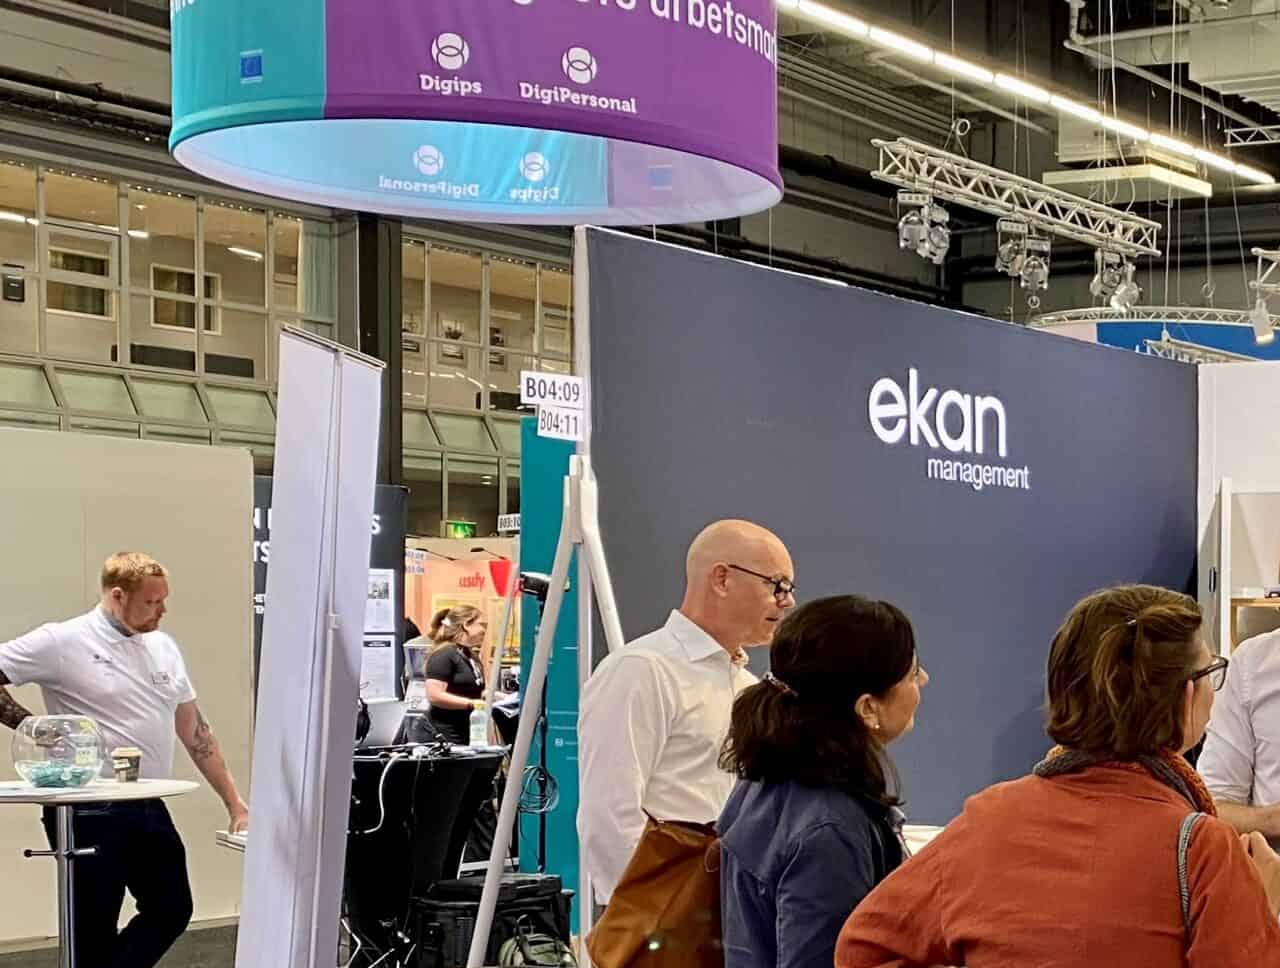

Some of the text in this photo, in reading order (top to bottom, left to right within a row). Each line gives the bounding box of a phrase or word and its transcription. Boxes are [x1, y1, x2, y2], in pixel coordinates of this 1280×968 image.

[419, 73, 482, 96] Digips
[519, 82, 637, 114] DigiPersonal
[526, 376, 580, 402] B04:09
[540, 409, 578, 435] B04:11
[869, 368, 1007, 458] ekan
[927, 457, 1030, 491] management
